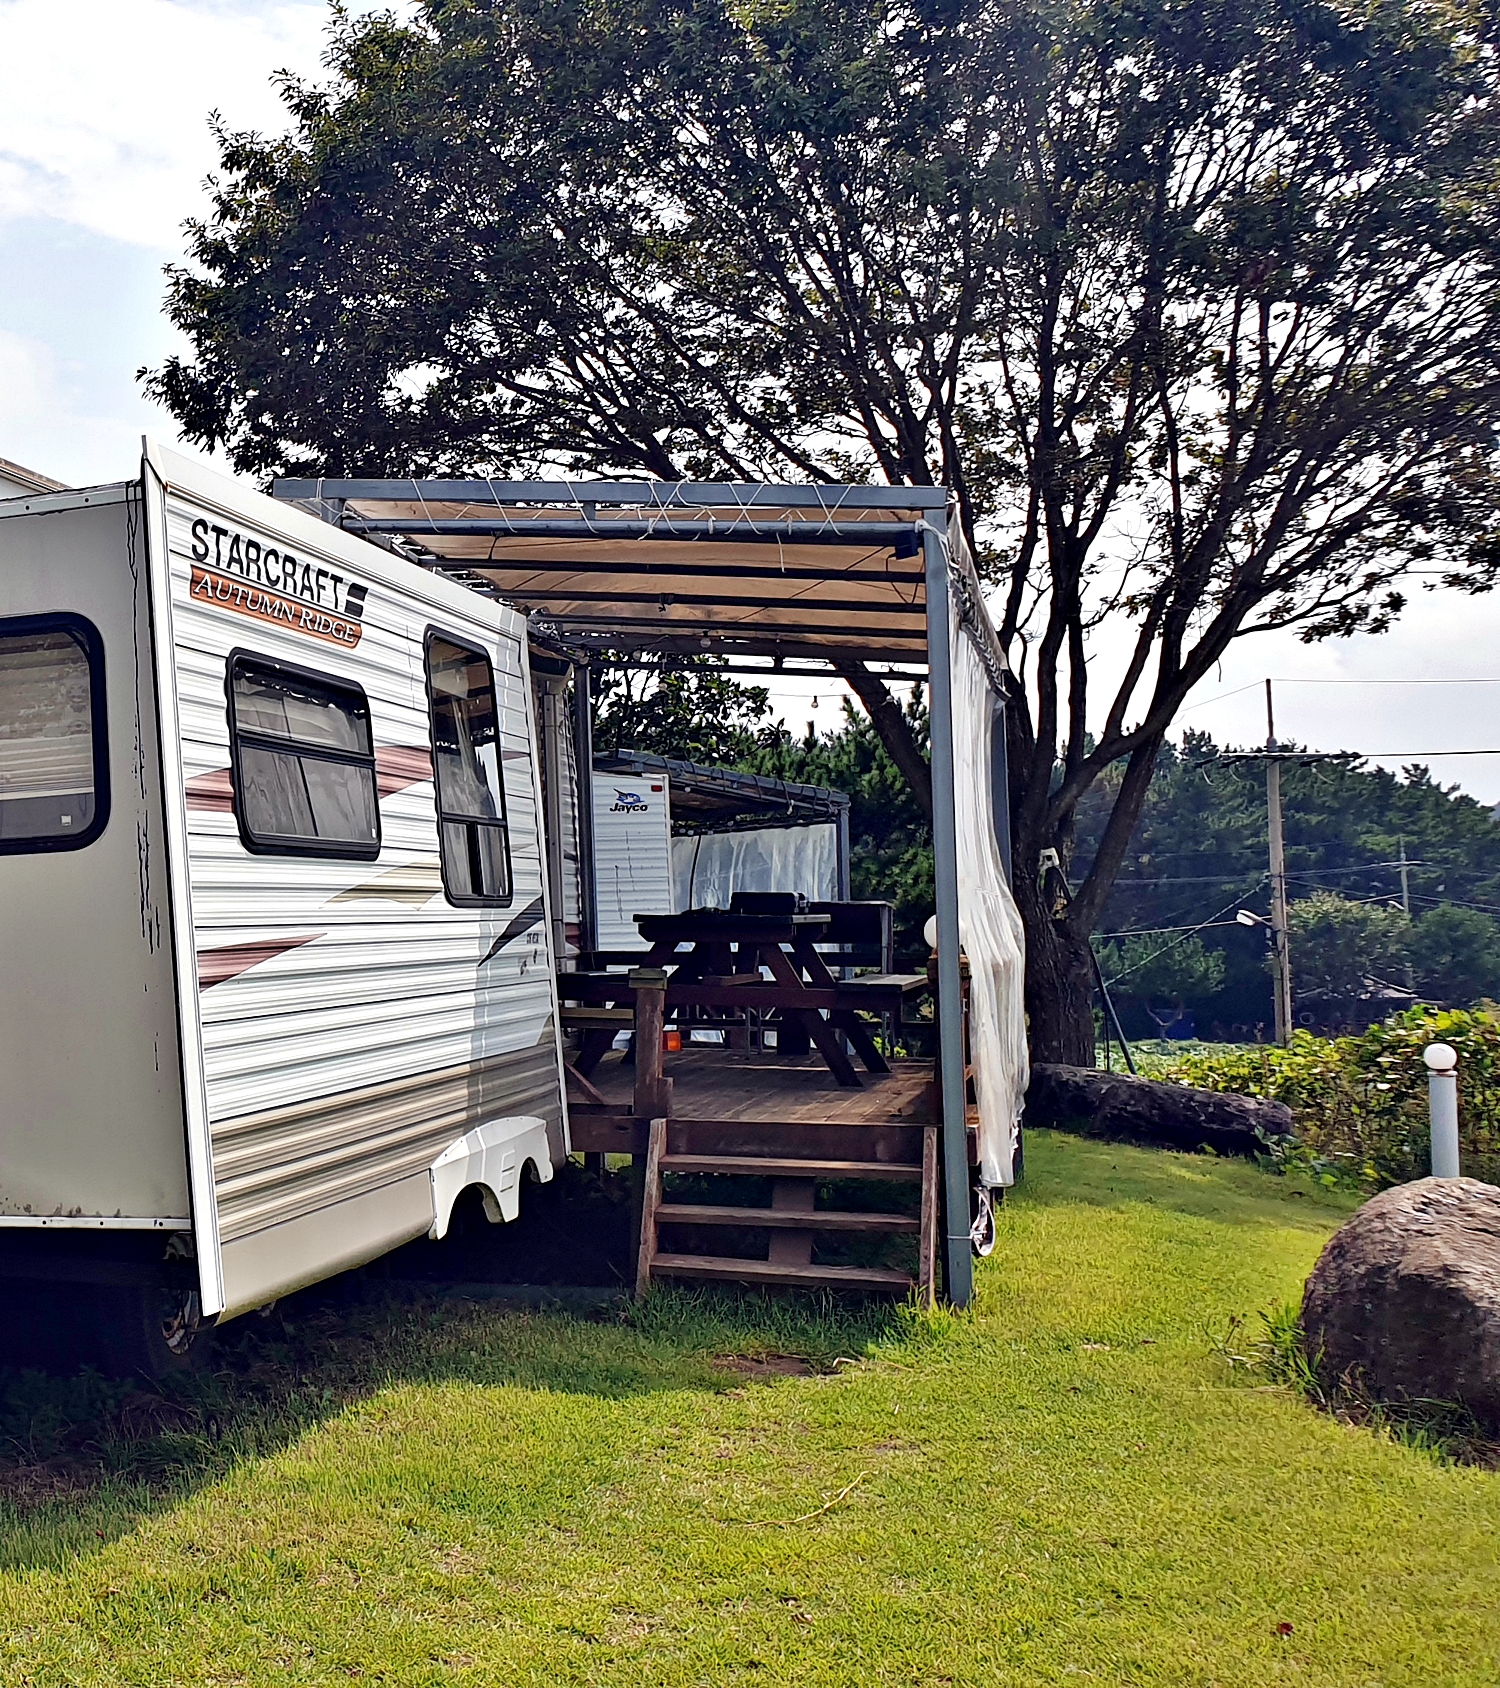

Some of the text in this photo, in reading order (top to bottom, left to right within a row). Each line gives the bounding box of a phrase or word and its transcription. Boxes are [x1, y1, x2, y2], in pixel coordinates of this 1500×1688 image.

[191, 518, 343, 610] STARCRAFT
[194, 573, 356, 643] AUTUMN RIDGE
[609, 802, 648, 814] Jayco
